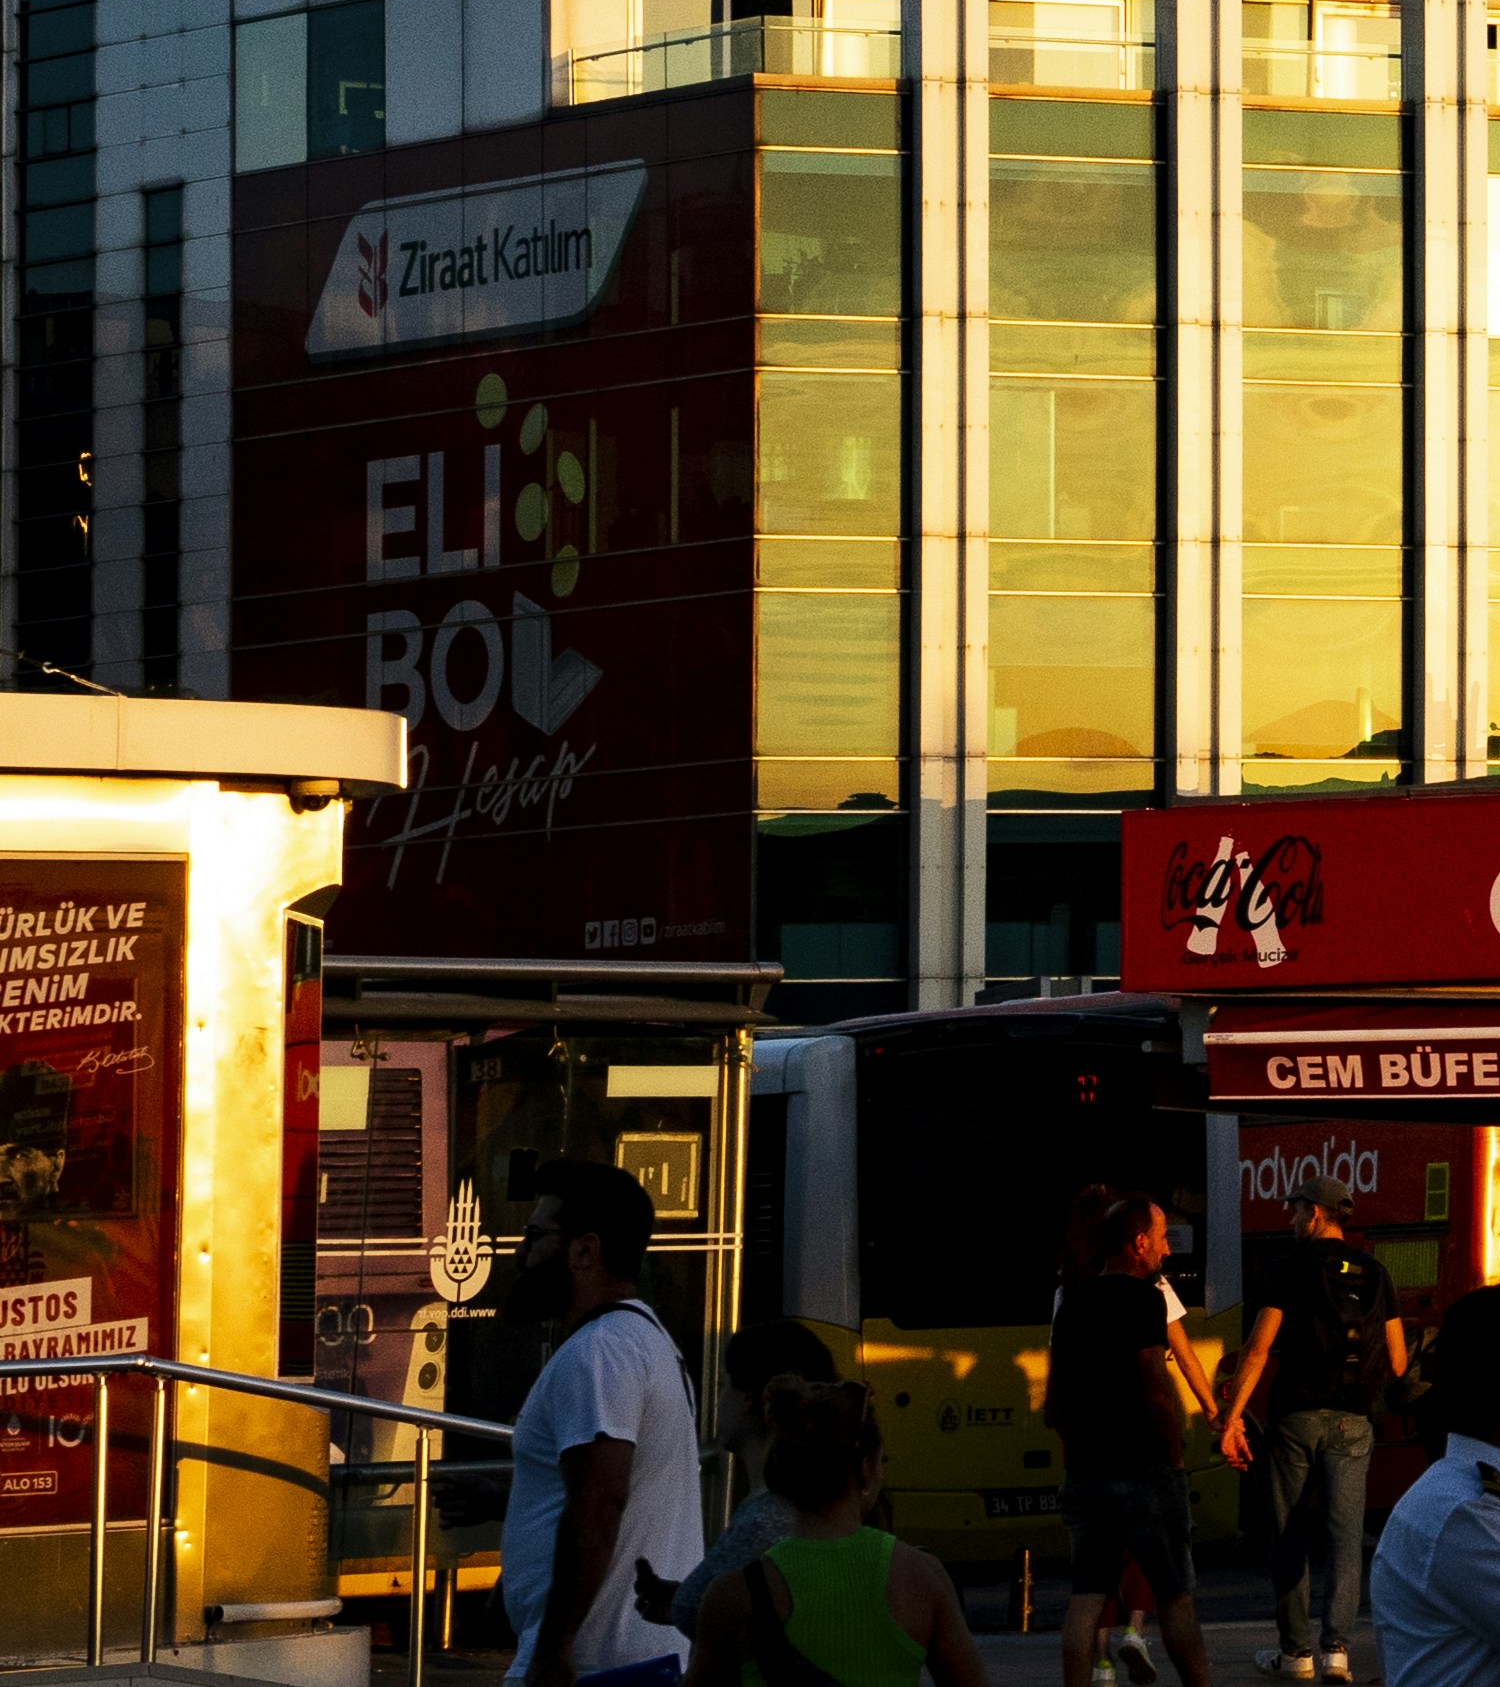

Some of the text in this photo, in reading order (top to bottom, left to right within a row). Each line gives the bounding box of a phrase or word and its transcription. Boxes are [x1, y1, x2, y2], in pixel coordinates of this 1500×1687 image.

[400, 219, 592, 298] Ziraat Katılım
[106, 902, 147, 930] VE
[1266, 1046, 1500, 1089] CEM BÜFE
[4, 1325, 137, 1361] BAYRAMIMIZ
[966, 1404, 1014, 1422] İETT
[4, 1477, 53, 1490] ALO 153
[991, 1496, 1009, 1512] 34
[1017, 1495, 1033, 1512] TP
